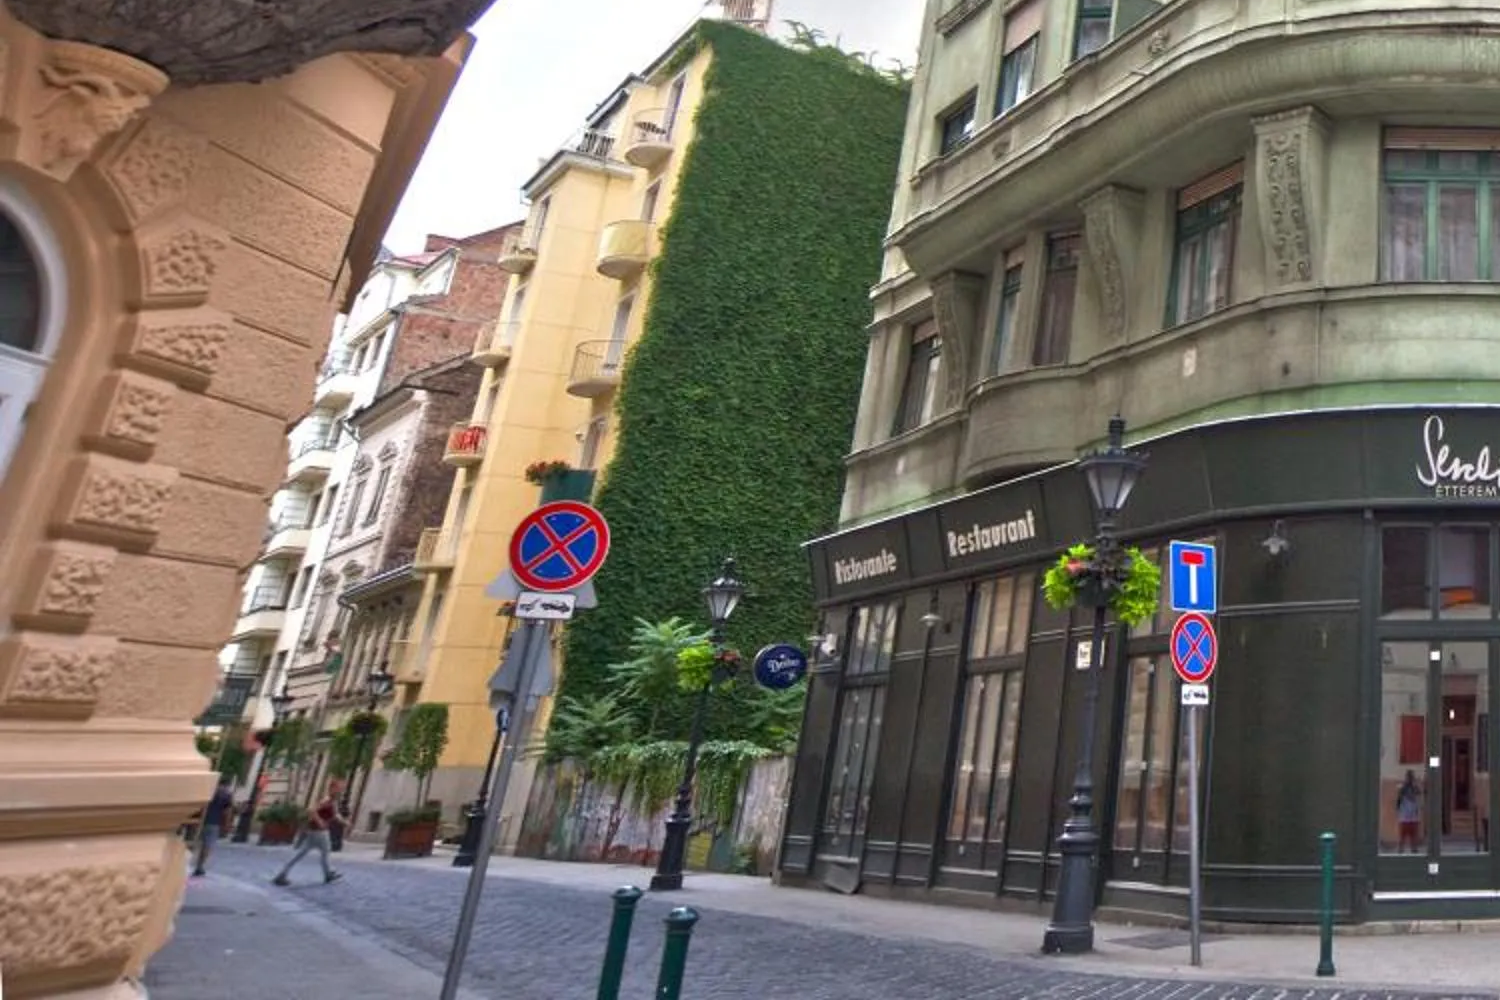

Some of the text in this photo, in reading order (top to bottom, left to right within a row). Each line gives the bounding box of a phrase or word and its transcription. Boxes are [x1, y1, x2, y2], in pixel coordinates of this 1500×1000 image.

[1435, 483, 1498, 497] ÉTTEREM
[947, 509, 1035, 557] Restaurant
[834, 548, 897, 584] Ristorante
